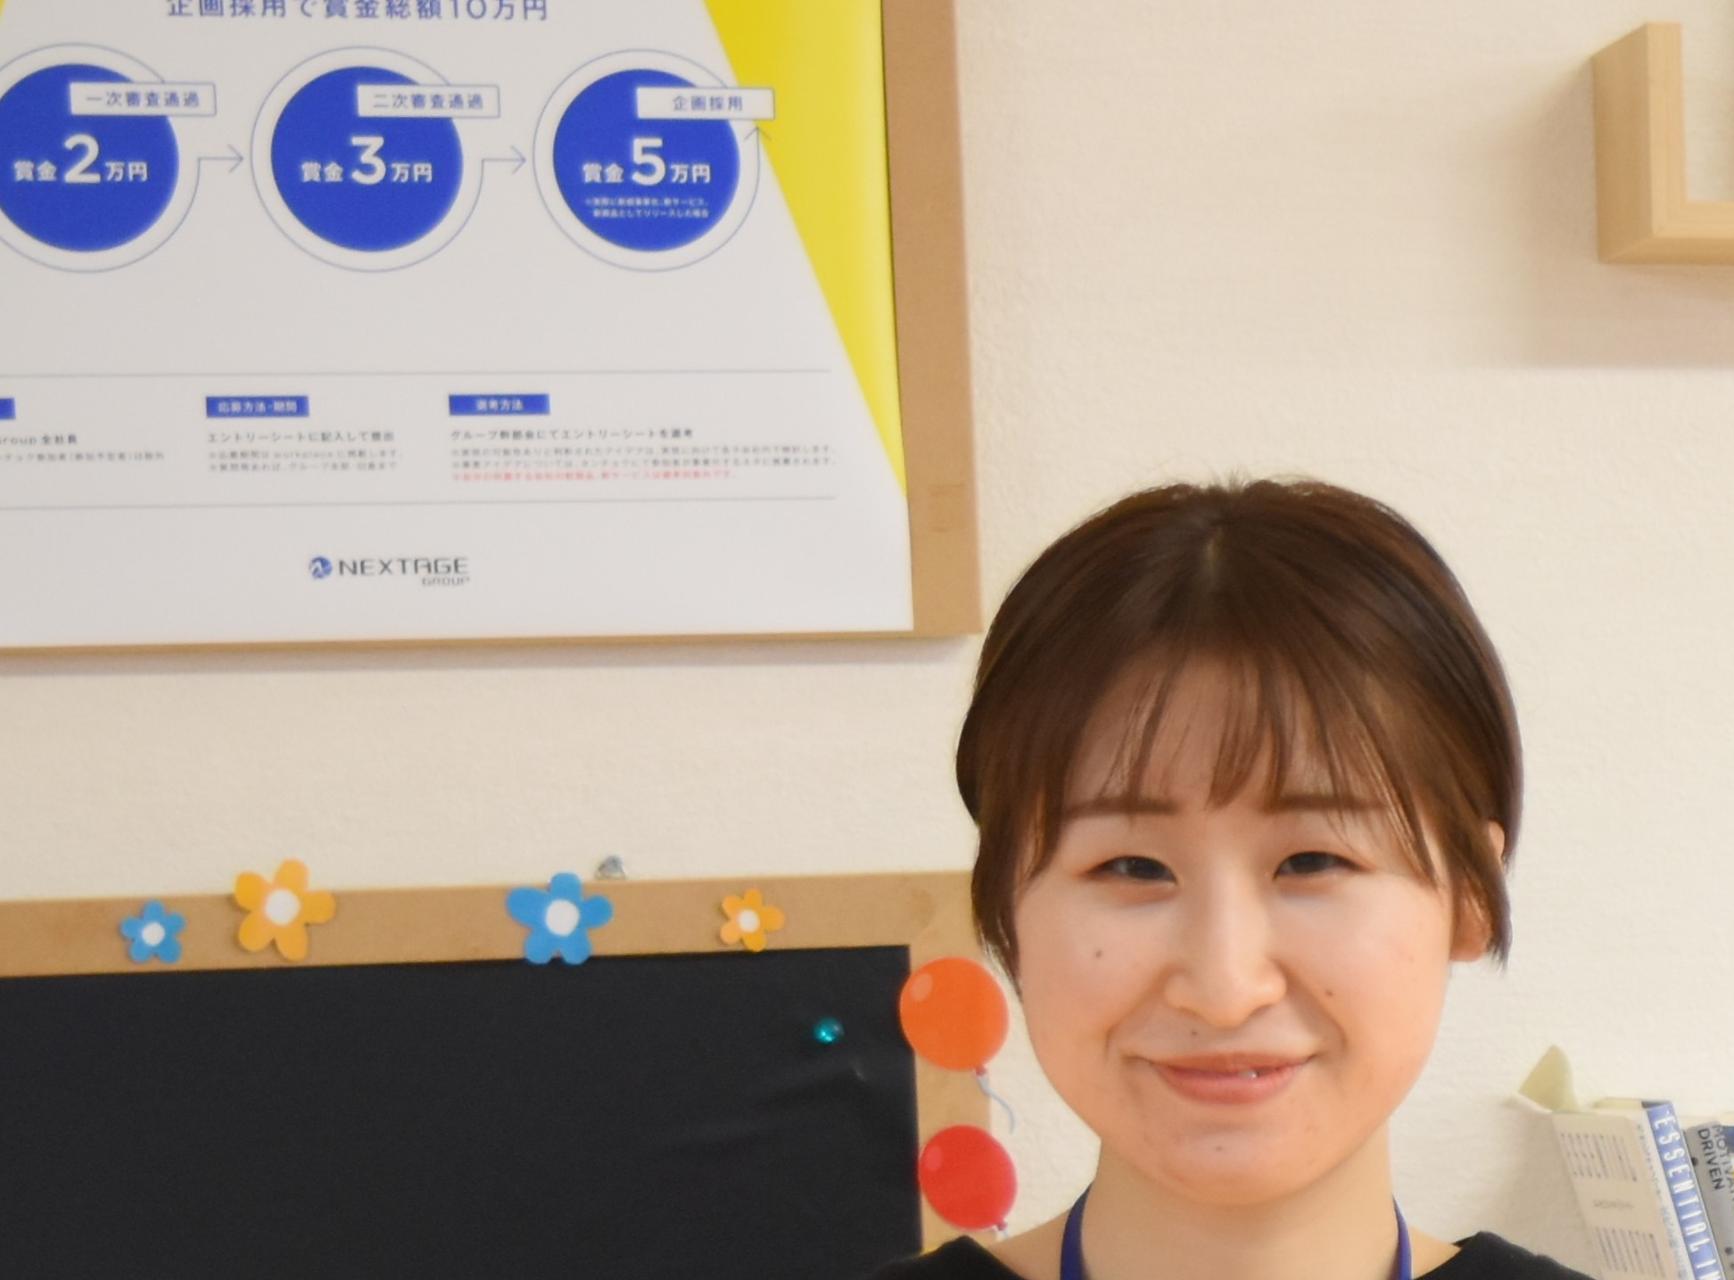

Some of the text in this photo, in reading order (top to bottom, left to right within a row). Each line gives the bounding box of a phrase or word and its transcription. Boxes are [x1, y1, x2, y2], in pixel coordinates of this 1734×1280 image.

[86, 90, 200, 108] 一次審査通過
[373, 93, 484, 110] 二次審査通過
[672, 95, 743, 112] 企画採用
[13, 134, 148, 185] 賞金2万円
[302, 135, 432, 185] 賞金3万円
[582, 137, 711, 186] 賞金5万円
[339, 558, 469, 575] NEXTAGE
[1696, 1127, 1724, 1191] DRIVEN
